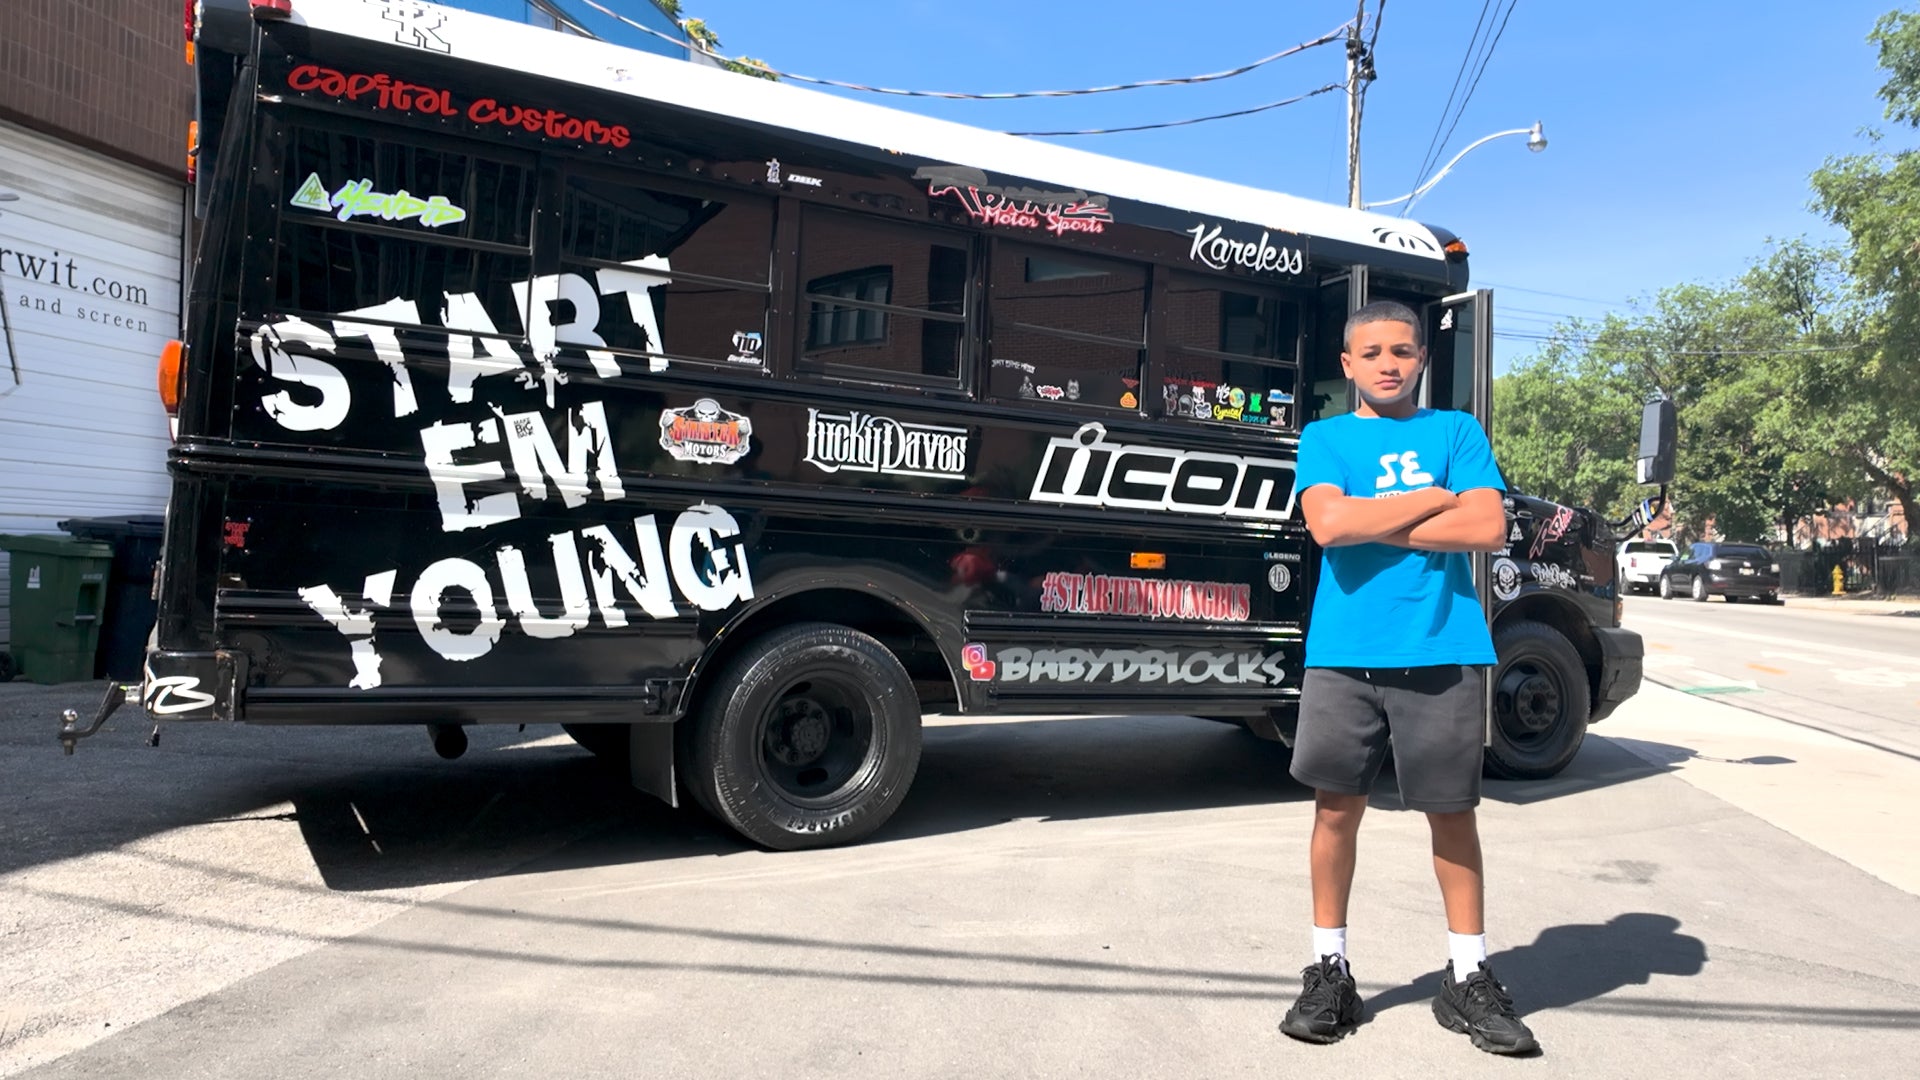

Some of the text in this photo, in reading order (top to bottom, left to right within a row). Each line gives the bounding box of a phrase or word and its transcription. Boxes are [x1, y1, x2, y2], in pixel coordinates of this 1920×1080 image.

[467, 98, 632, 148] Customs
[983, 206, 1105, 237] Motor Sports
[1186, 223, 1303, 275] Kareless
[19, 294, 149, 333] and screen
[250, 253, 672, 431] START
[420, 400, 626, 532] EM
[684, 441, 728, 458] MOTORS
[297, 500, 755, 690] YOUNG
[1040, 572, 1251, 621] #STARTEMYOUNGBUS
[997, 646, 1286, 686] BABYDBLOCKS
